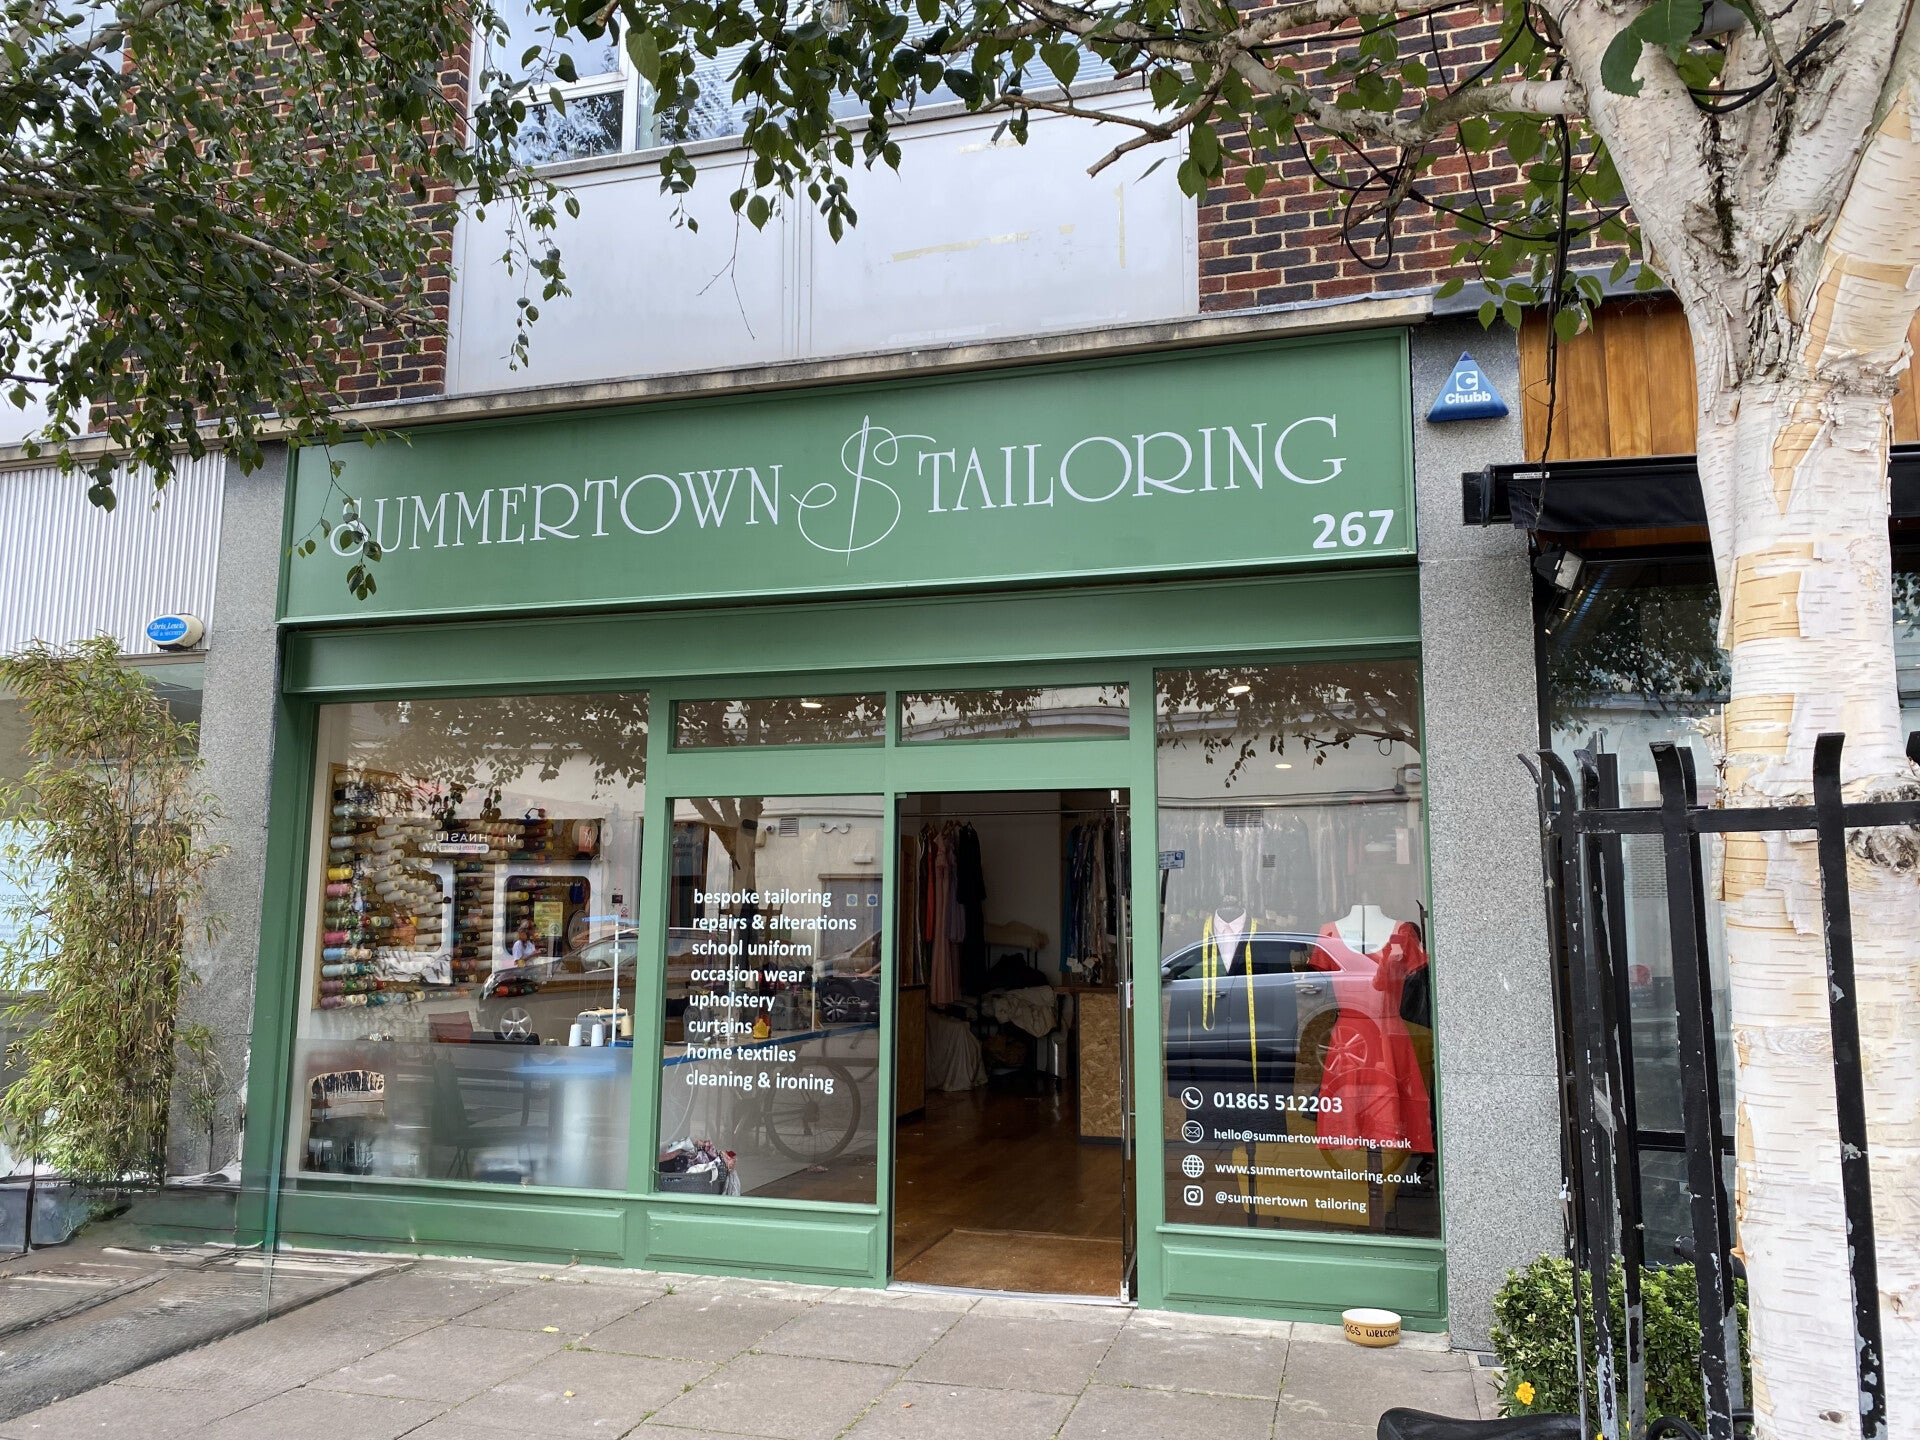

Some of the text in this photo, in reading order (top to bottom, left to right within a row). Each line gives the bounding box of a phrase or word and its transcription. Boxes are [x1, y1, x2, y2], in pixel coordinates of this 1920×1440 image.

[1445, 391, 1492, 404] Chubb
[330, 464, 783, 557] SUMMERTOWN
[918, 413, 1347, 513] TAILORING
[1312, 509, 1395, 549] 267
[694, 888, 832, 908] bespoke tailoring
[692, 914, 857, 932] repairs & alterations
[691, 939, 812, 956] school uniform
[690, 964, 806, 983] occasion wear
[689, 990, 776, 1012] upholstery
[688, 1018, 753, 1035] curtains
[686, 1042, 797, 1062] home textiles
[685, 1069, 835, 1095] cleaning & ironing
[1213, 1091, 1343, 1113] 01865 512203
[1213, 1128, 1412, 1149] hello@summertowntailoring.co.uk
[1214, 1163, 1422, 1184] www.summertowntailoring.co.uk
[1215, 1190, 1367, 1213] @summertown tailoring
[1344, 1323, 1361, 1336] OGS
